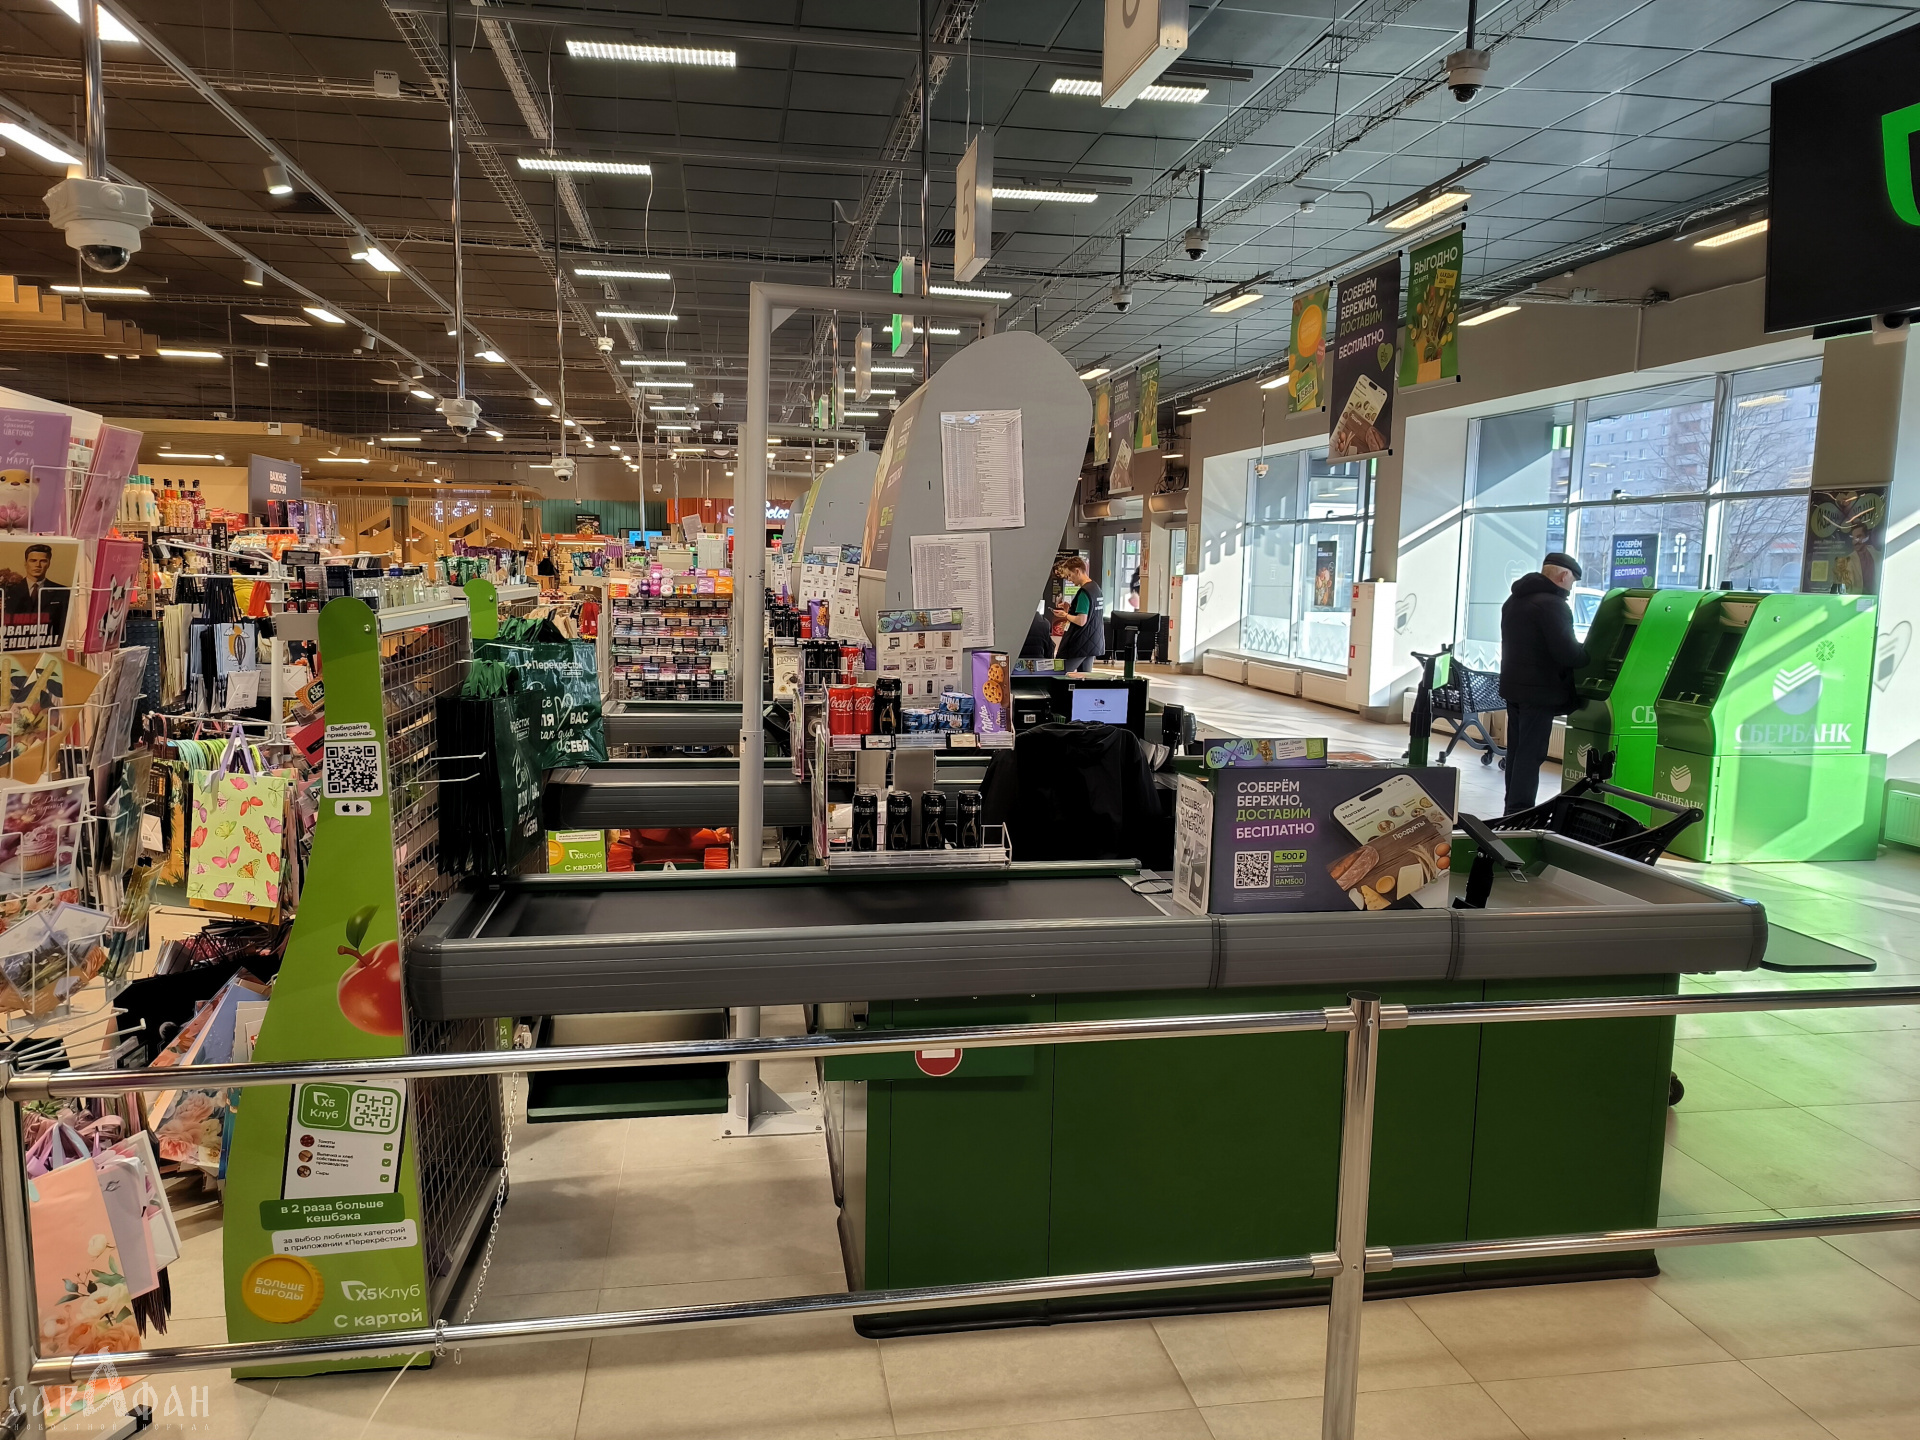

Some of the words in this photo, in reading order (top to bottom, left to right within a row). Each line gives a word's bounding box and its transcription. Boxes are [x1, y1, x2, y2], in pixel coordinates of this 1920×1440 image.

[1413, 246, 1458, 276] ВЫГОДНО
[1341, 277, 1377, 303] СОБЕРЁМ
[1340, 295, 1378, 320] БЕРЕЖНО,
[1339, 308, 1383, 339] ДОСТАВИМ
[1338, 328, 1385, 360] БЕСПЛАТНО
[3, 428, 34, 438] ЦВЕТОЧКУ
[6, 456, 35, 466] МАРТА
[269, 470, 288, 483] ВАЖНЫЕ
[269, 483, 288, 495] МЕЛОЧИ
[1616, 538, 1643, 548] СОБЕРЁМ
[1615, 548, 1643, 558] БЕРЕЖНО,
[1614, 557, 1646, 565] ДОСТАВИМ
[1614, 567, 1648, 577] БЕСПЛАТНО
[1, 635, 59, 649] ЕНЩИНА!
[532, 660, 583, 671] Перекрёсток
[310, 683, 322, 695] tic
[569, 711, 589, 725] ВАС
[978, 705, 994, 733] Milka
[330, 724, 368, 732] Выбирайте
[1733, 723, 1852, 744] СБЕРБАНК
[564, 740, 590, 754] СЕБЯ
[1237, 778, 1300, 793] СОБЕРЁМ
[1236, 795, 1303, 808] БЕРЕЖНО,
[1235, 807, 1311, 822] ДОСТАВИМ
[1342, 806, 1367, 820] Магазин
[1236, 822, 1315, 840] БЕСПЛАТНО
[1392, 820, 1426, 841] Продукты
[1282, 852, 1298, 860] 500
[564, 864, 571, 872] С
[572, 863, 603, 873] картой
[320, 1097, 336, 1108] X5
[310, 1108, 339, 1121] Клуб
[281, 1205, 288, 1214] в
[291, 1204, 300, 1213] 2
[302, 1204, 333, 1215] раза
[335, 1199, 384, 1211] больше
[306, 1212, 361, 1224] кешбэка
[294, 1234, 322, 1244] выбор
[323, 1231, 362, 1240] любимых
[363, 1226, 406, 1237] категорий
[291, 1240, 343, 1251] приложении
[344, 1235, 407, 1247] «Перекресток»
[255, 1277, 306, 1292] БОЛЬШЕ
[253, 1286, 304, 1300] ВЫГОДЫ
[334, 1314, 349, 1328] С
[354, 1308, 423, 1328] картой
